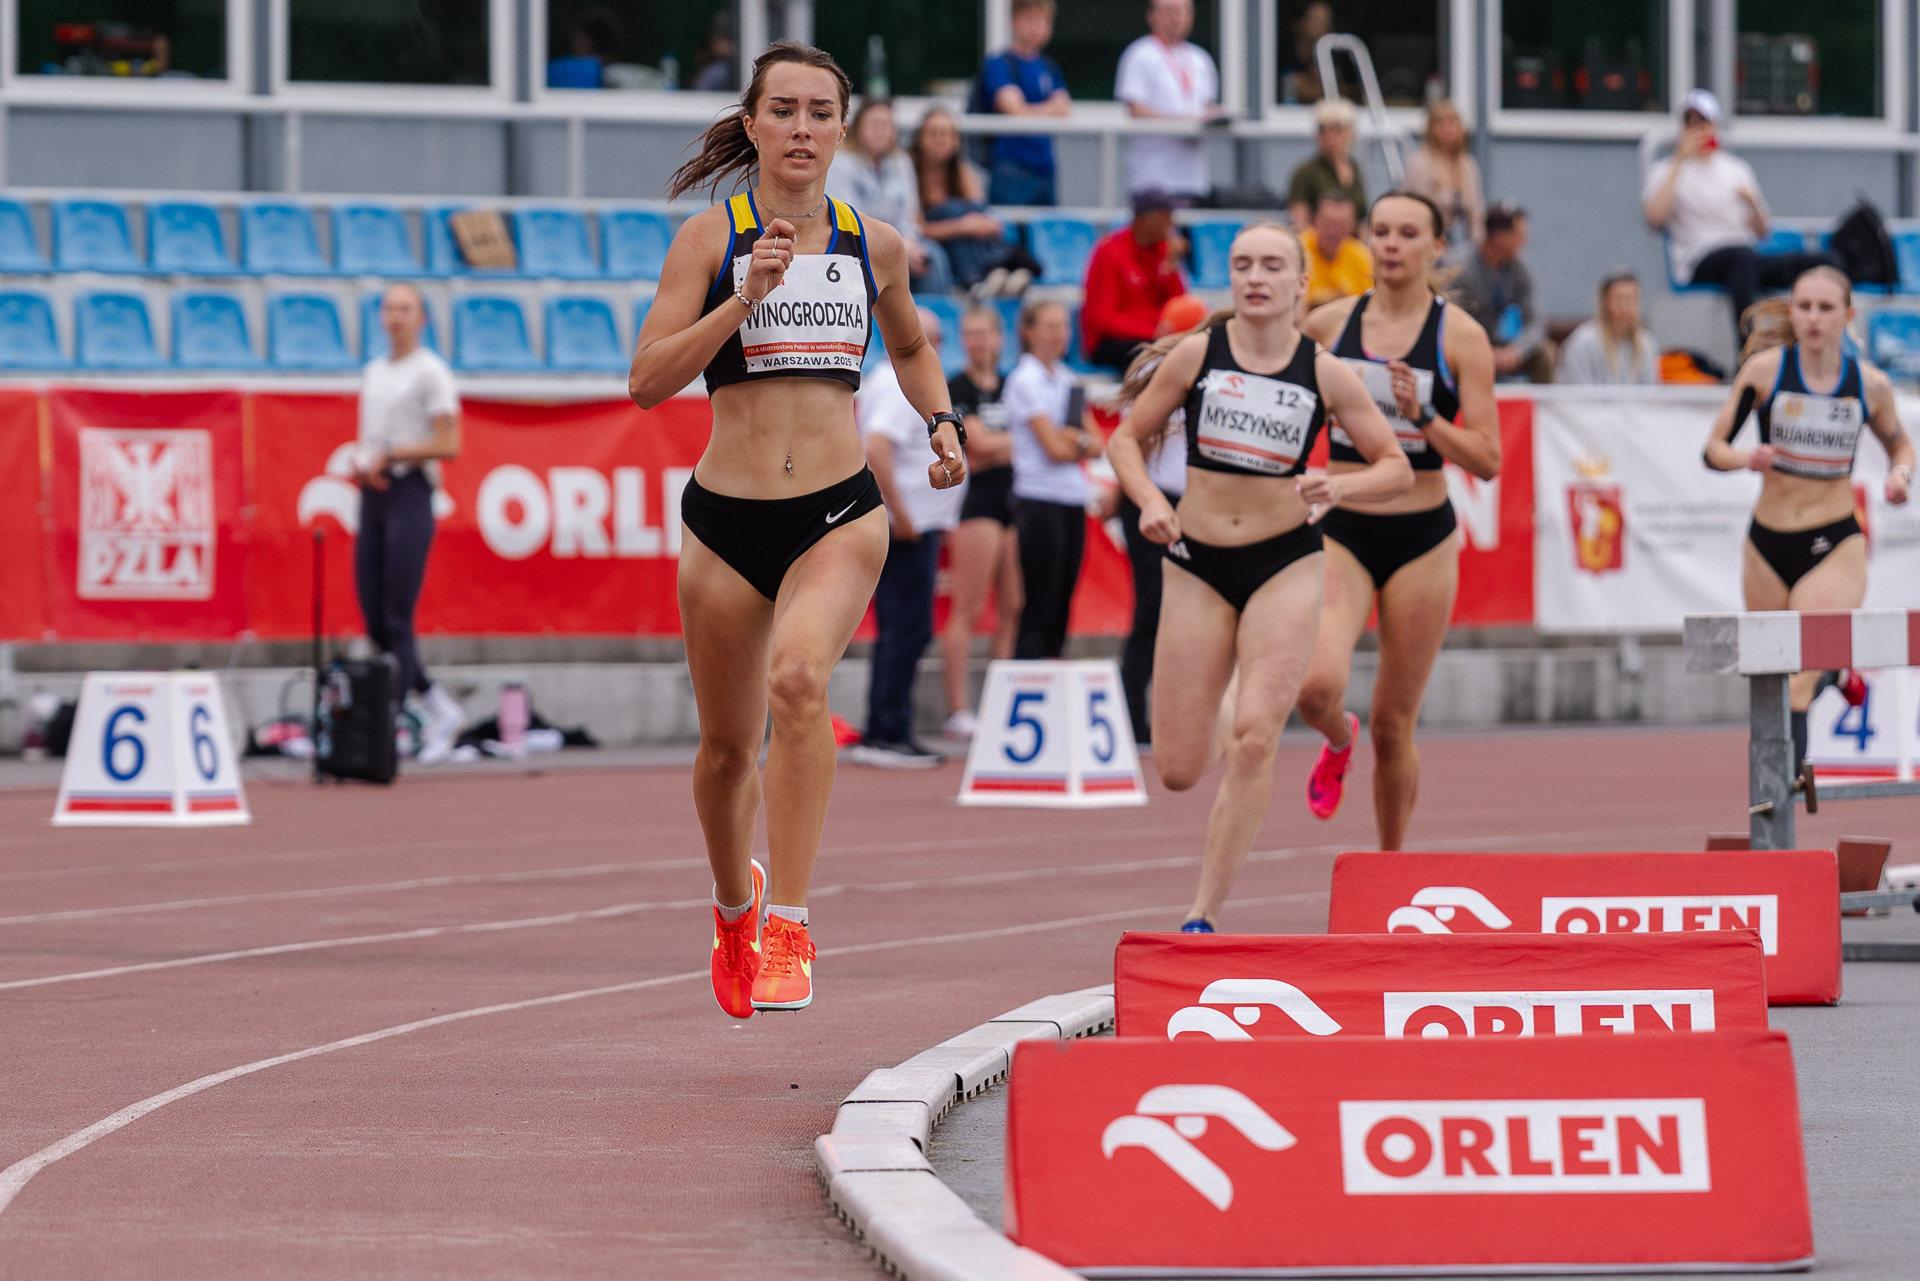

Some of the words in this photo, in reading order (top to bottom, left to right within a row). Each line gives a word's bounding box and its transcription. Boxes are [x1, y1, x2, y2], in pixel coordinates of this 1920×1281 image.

[826, 261, 841, 282] 6
[746, 302, 863, 329] WINOGRODZKA
[762, 356, 831, 367] WARSZAWA
[834, 356, 852, 367] 2025
[1204, 405, 1300, 446] MYSZYŃSKA
[1275, 389, 1300, 408] 12
[87, 539, 202, 583] PZLA
[191, 704, 218, 782] 6
[1005, 691, 1045, 763] 5
[1090, 691, 1115, 763] 5
[1833, 682, 1875, 751] 4
[103, 705, 146, 783] 6
[1363, 1114, 1683, 1178] ORLEN
